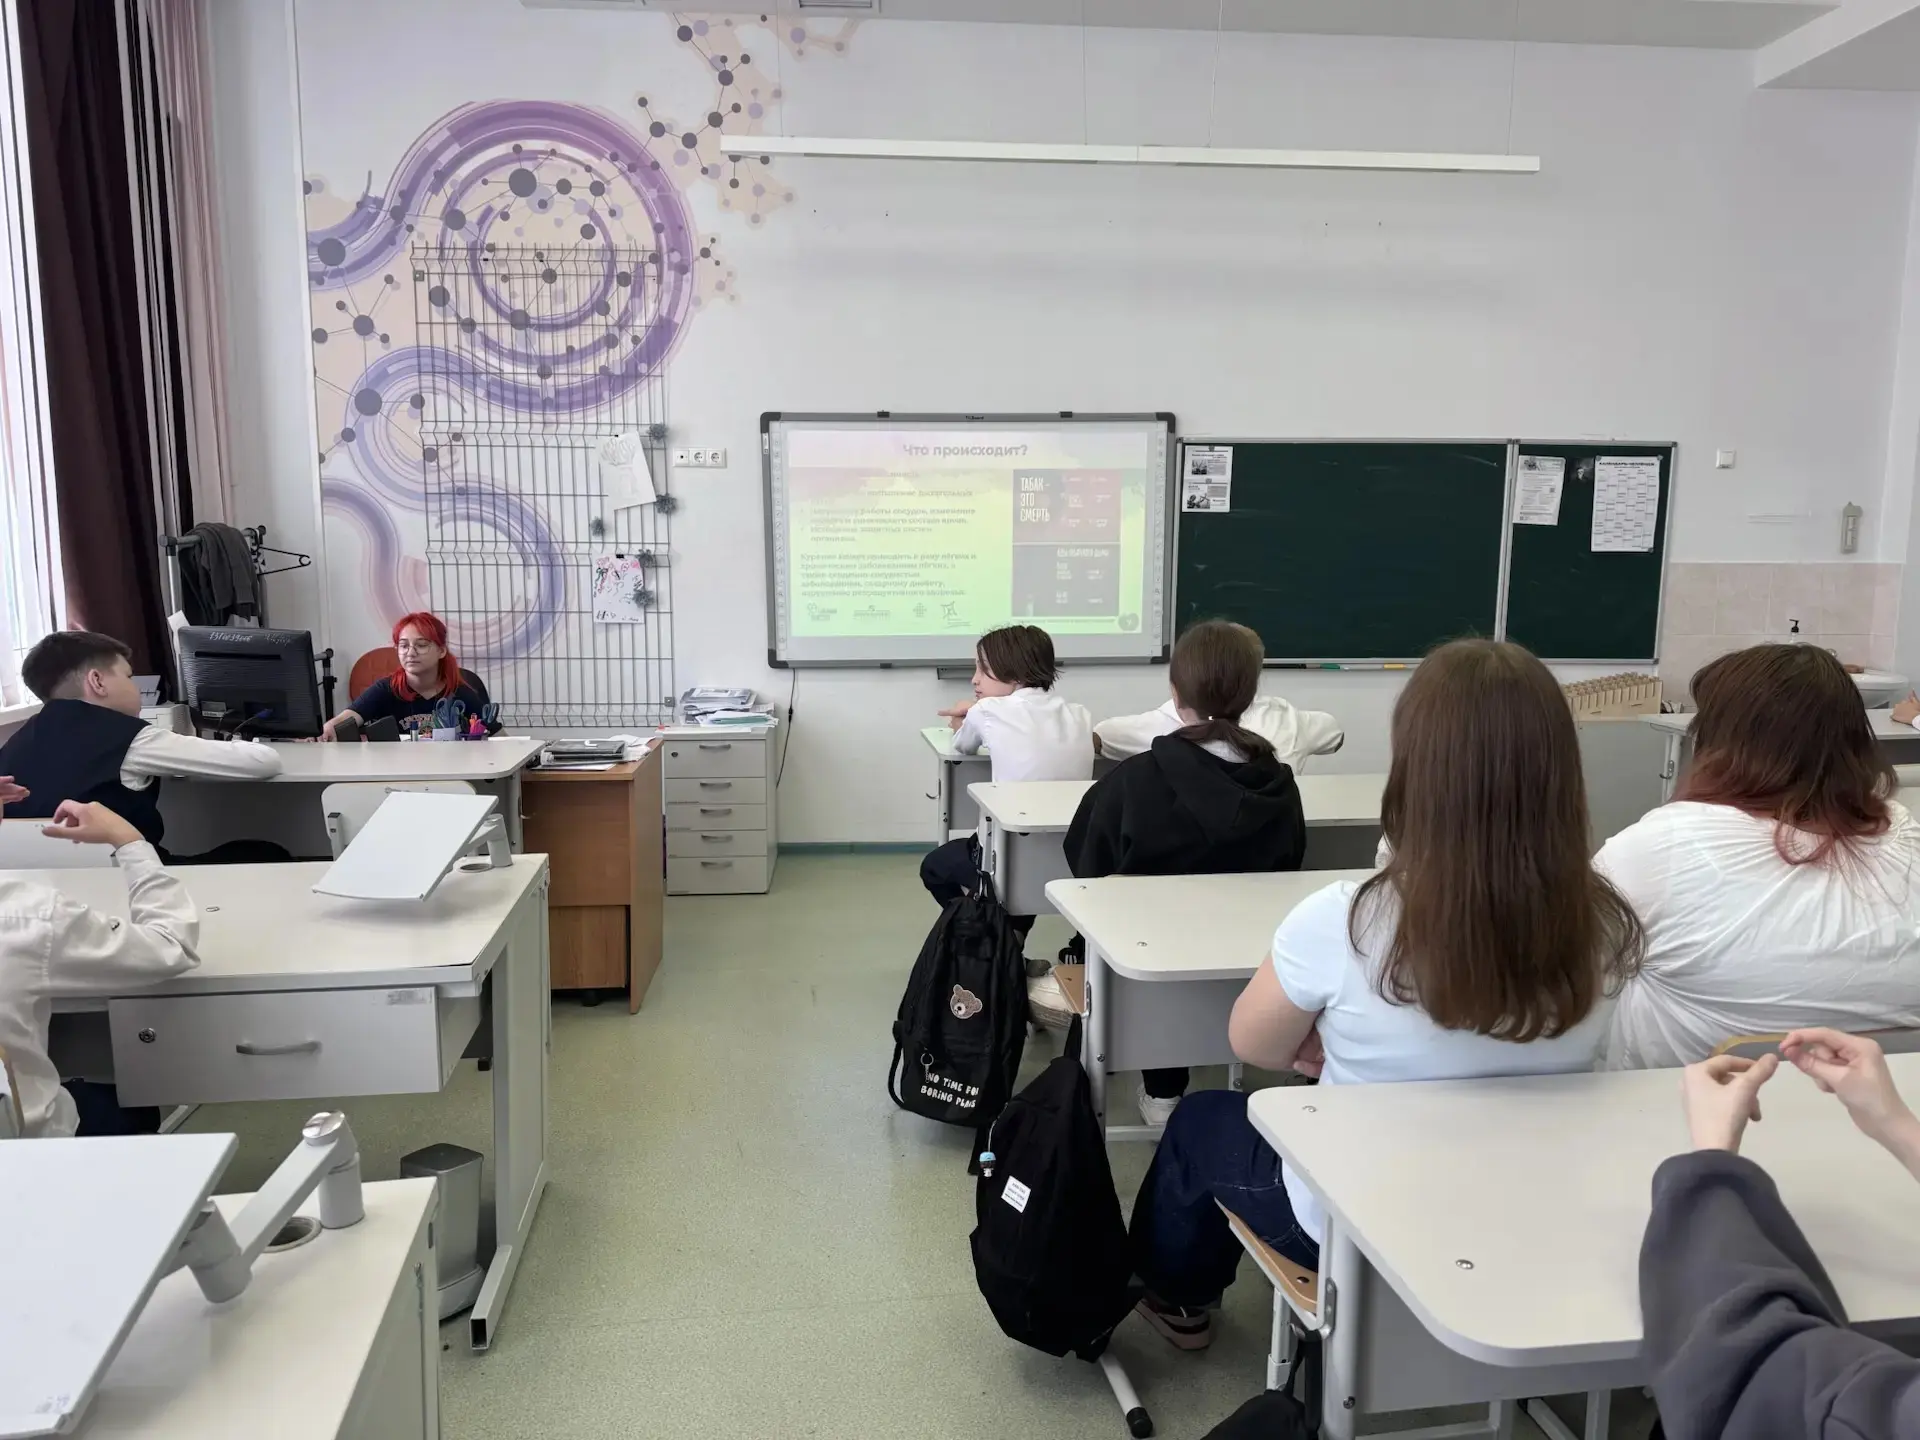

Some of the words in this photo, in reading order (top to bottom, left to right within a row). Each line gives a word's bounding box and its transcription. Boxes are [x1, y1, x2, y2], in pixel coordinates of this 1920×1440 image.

[902, 443, 929, 456] Что
[933, 443, 1029, 459] происходит?
[1020, 477, 1044, 492] ТАБАК
[1020, 493, 1035, 507] ЭТО
[1020, 508, 1050, 523] СМЕРТЬ
